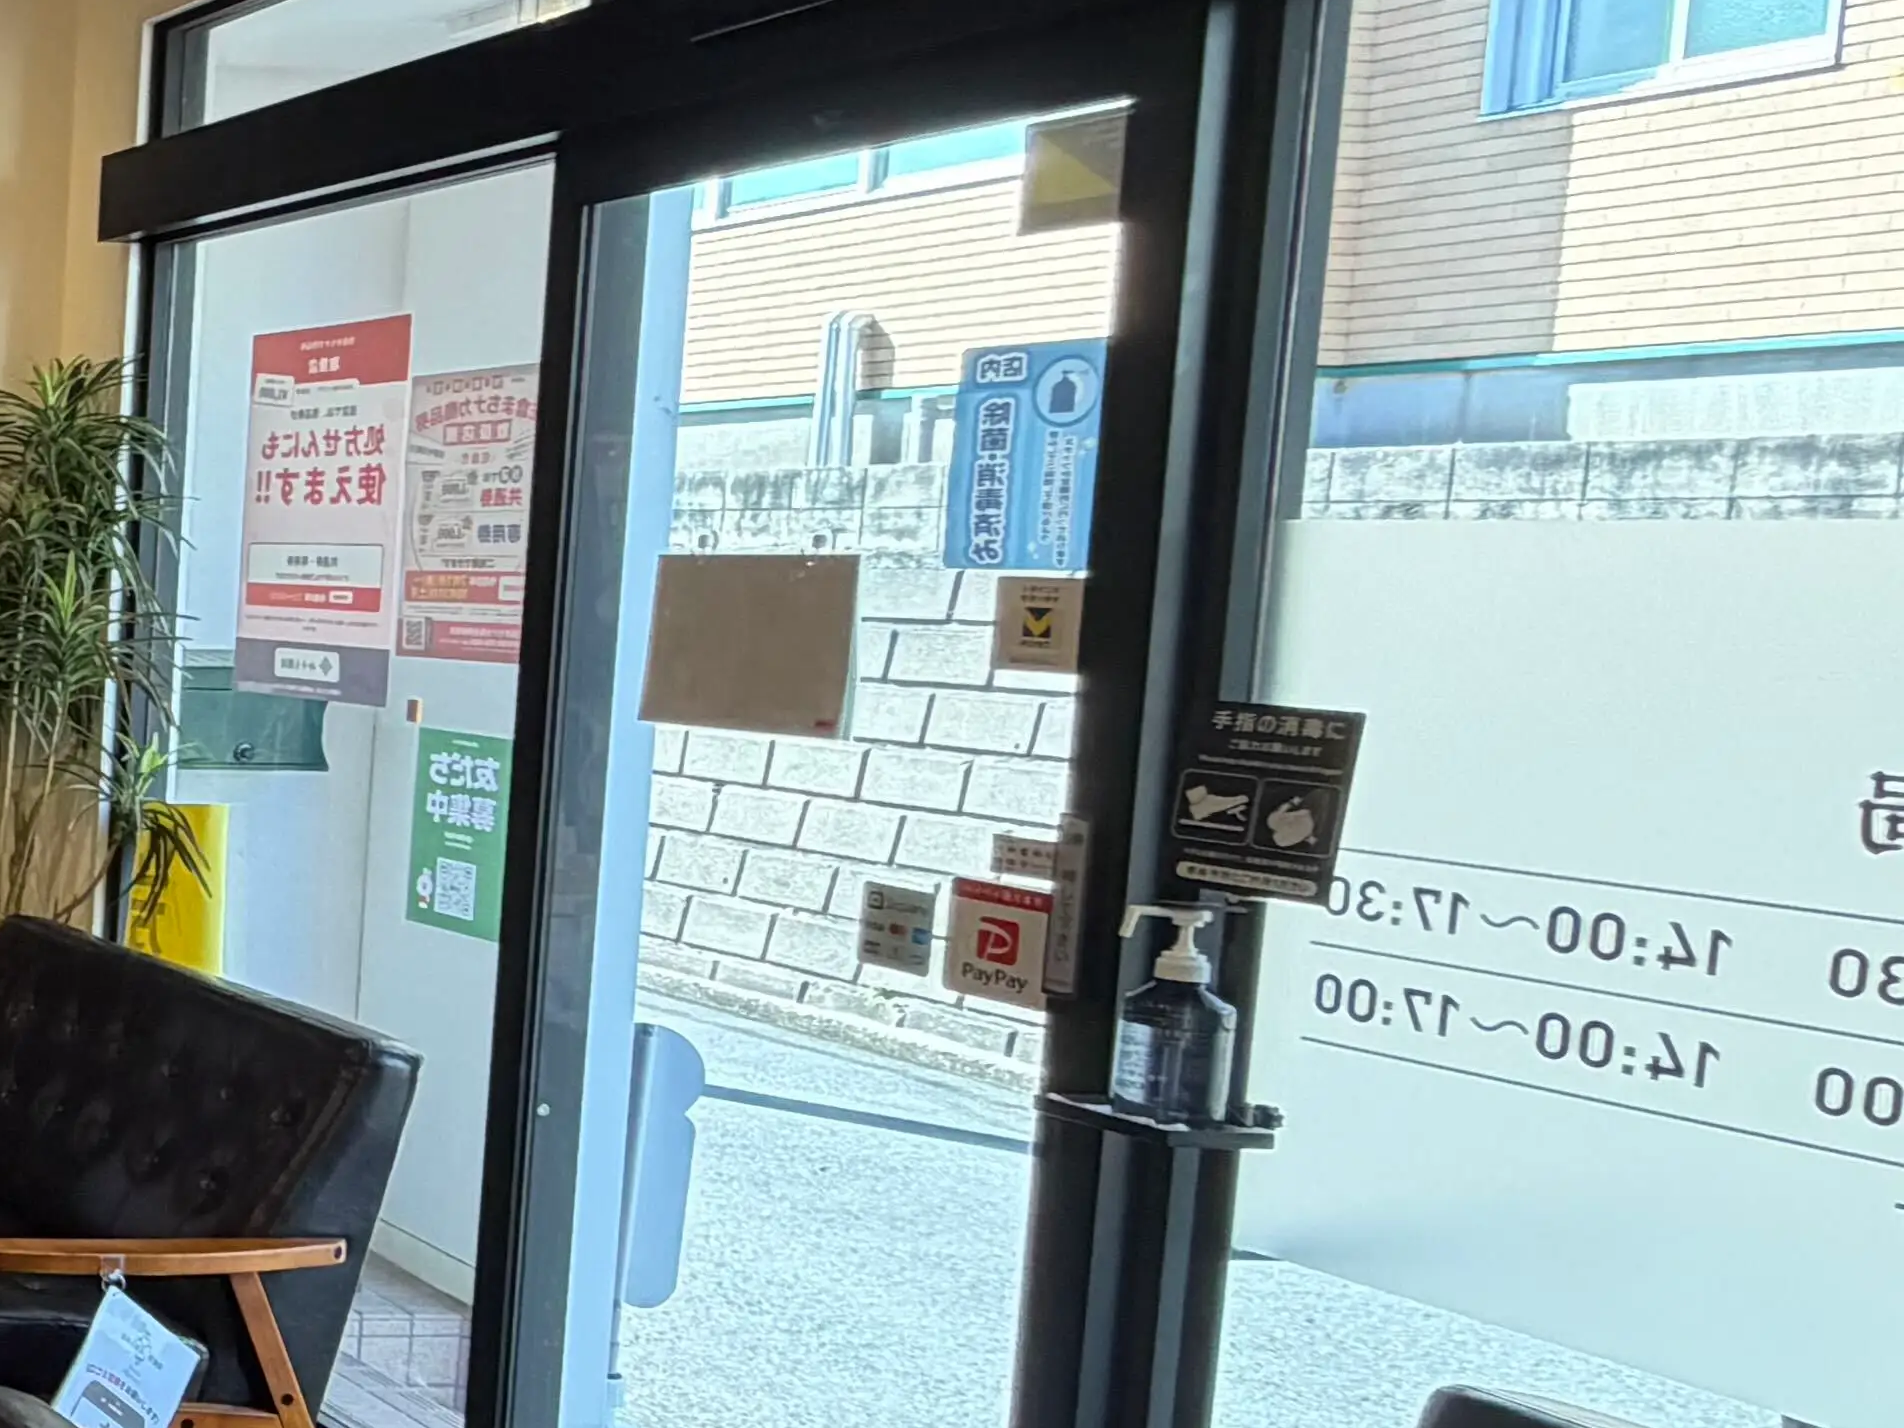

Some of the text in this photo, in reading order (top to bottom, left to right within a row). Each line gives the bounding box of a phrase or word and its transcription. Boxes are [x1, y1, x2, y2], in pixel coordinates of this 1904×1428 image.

[1212, 710, 1347, 740] 手指の消毒に
[961, 962, 1029, 994] PayPay
